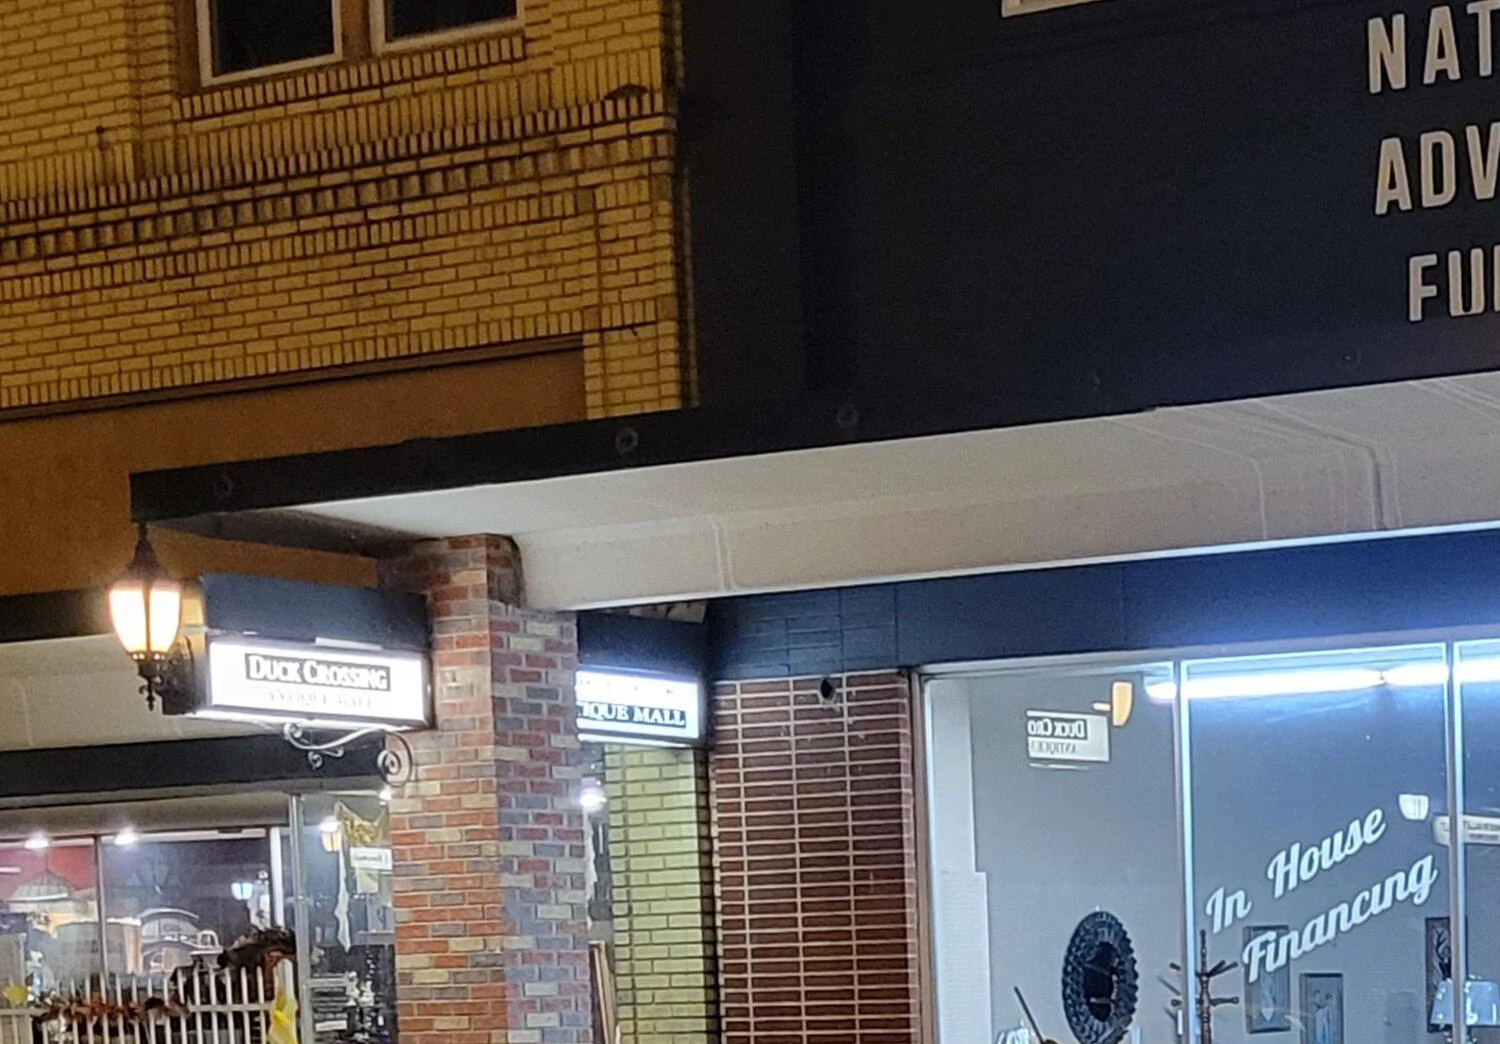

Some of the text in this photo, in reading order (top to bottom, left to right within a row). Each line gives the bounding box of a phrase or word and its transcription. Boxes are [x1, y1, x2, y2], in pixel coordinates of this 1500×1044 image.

[577, 700, 687, 727] IQUE MALL
[1205, 808, 1387, 935] In House
[1242, 854, 1439, 984] Financing
